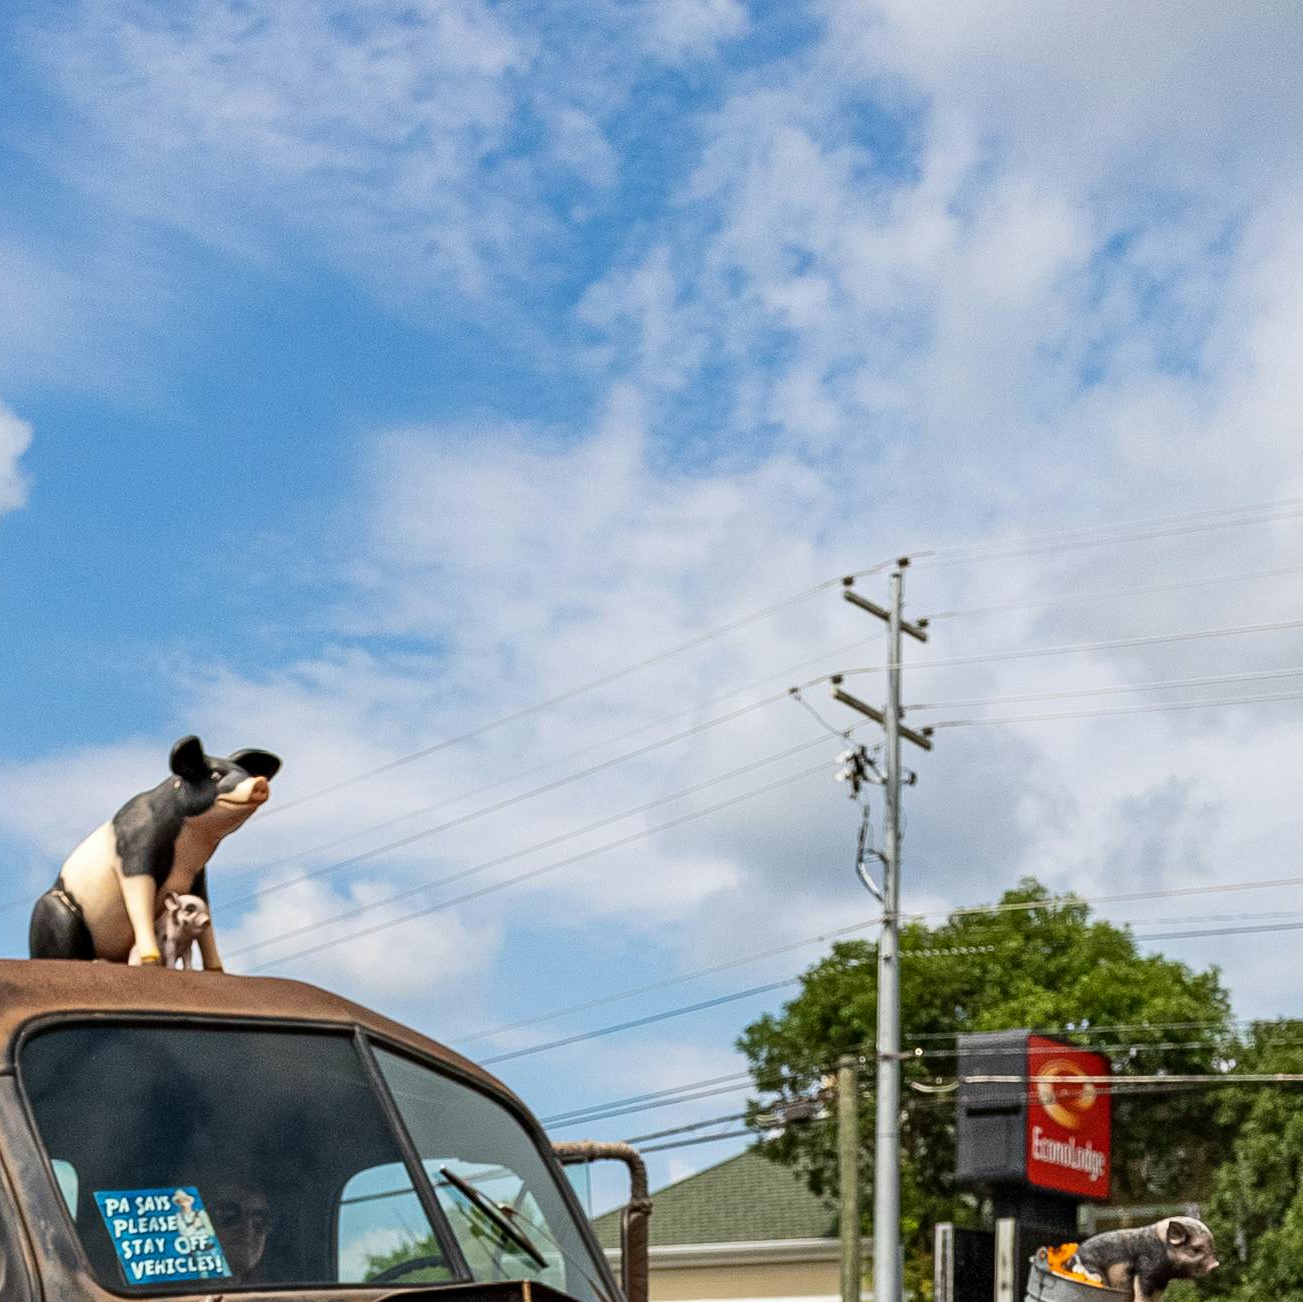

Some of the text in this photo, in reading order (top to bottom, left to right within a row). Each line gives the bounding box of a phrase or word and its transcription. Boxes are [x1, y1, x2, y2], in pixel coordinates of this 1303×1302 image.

[105, 1195, 171, 1217] PA SAYS
[113, 1215, 178, 1238] PLEASE
[121, 1235, 209, 1259] STAY OFF
[131, 1255, 223, 1280] VEHICLES!
